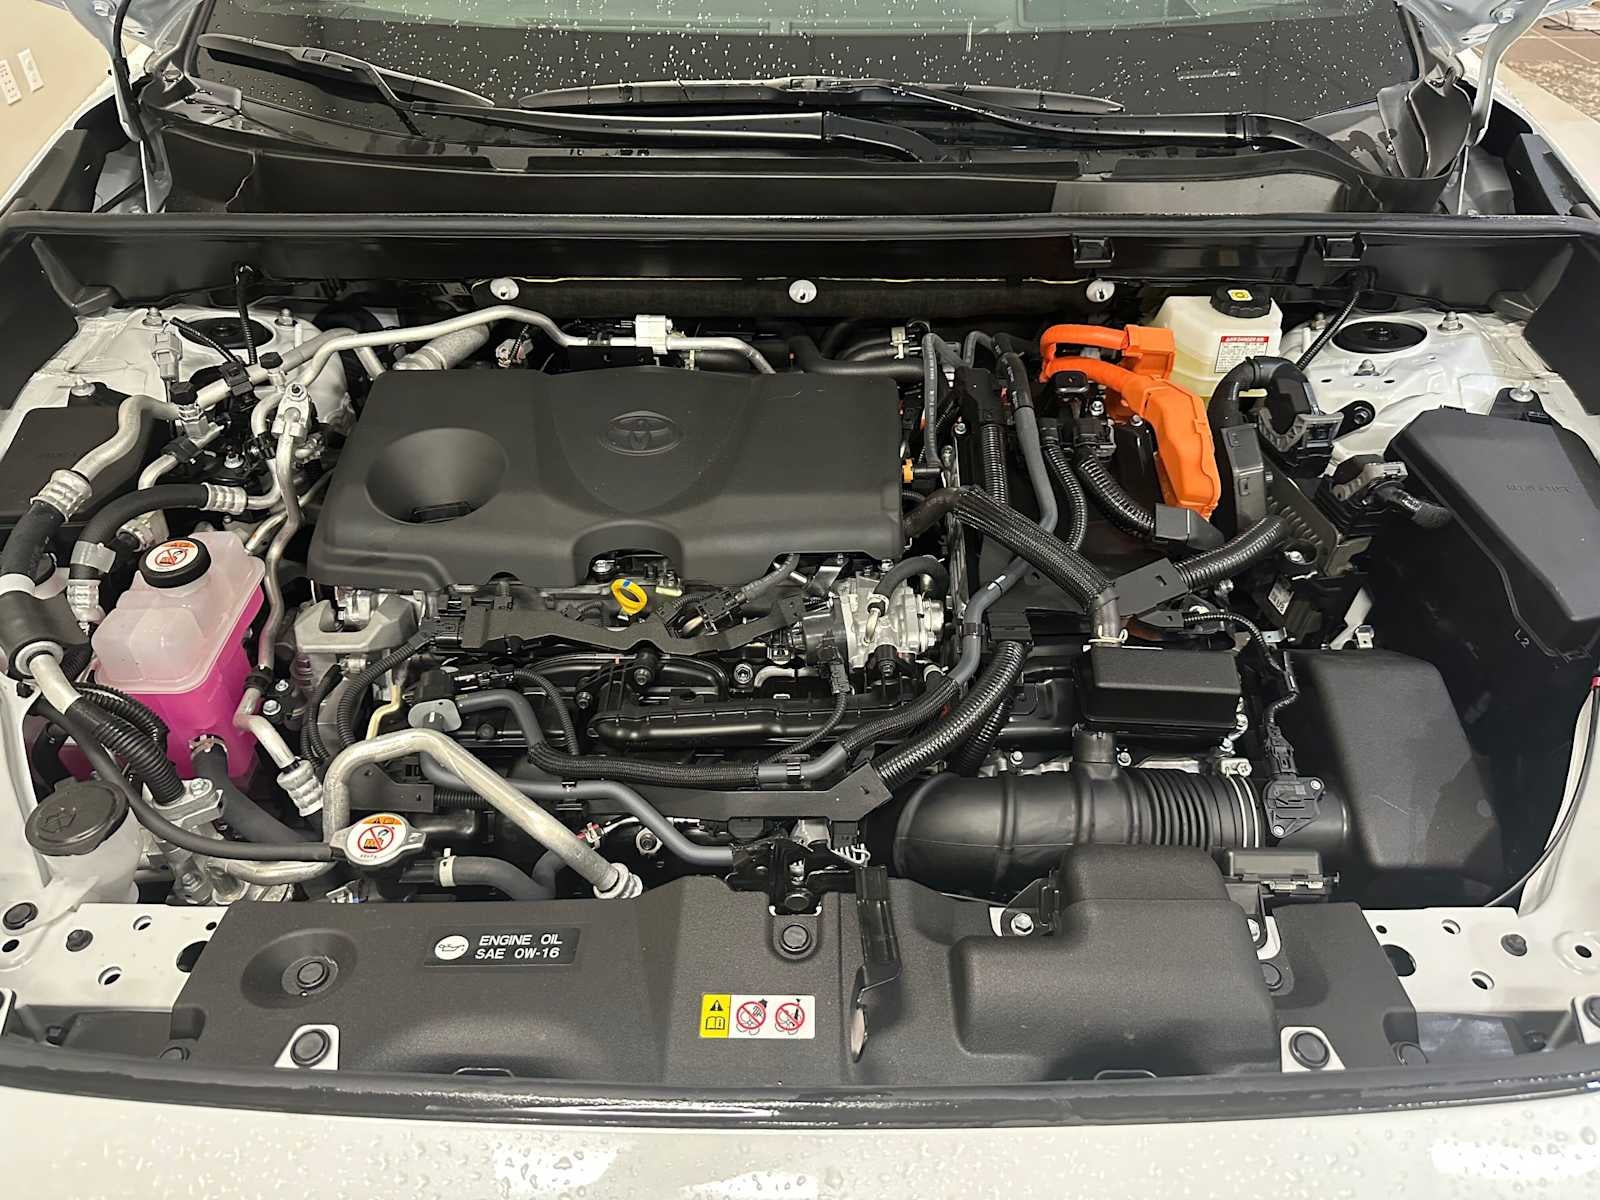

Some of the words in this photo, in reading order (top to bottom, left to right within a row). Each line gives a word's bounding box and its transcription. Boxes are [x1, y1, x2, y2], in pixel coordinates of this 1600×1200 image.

[479, 934, 533, 946] ENGINE
[540, 933, 563, 945] OIL
[474, 948, 506, 960] SAE
